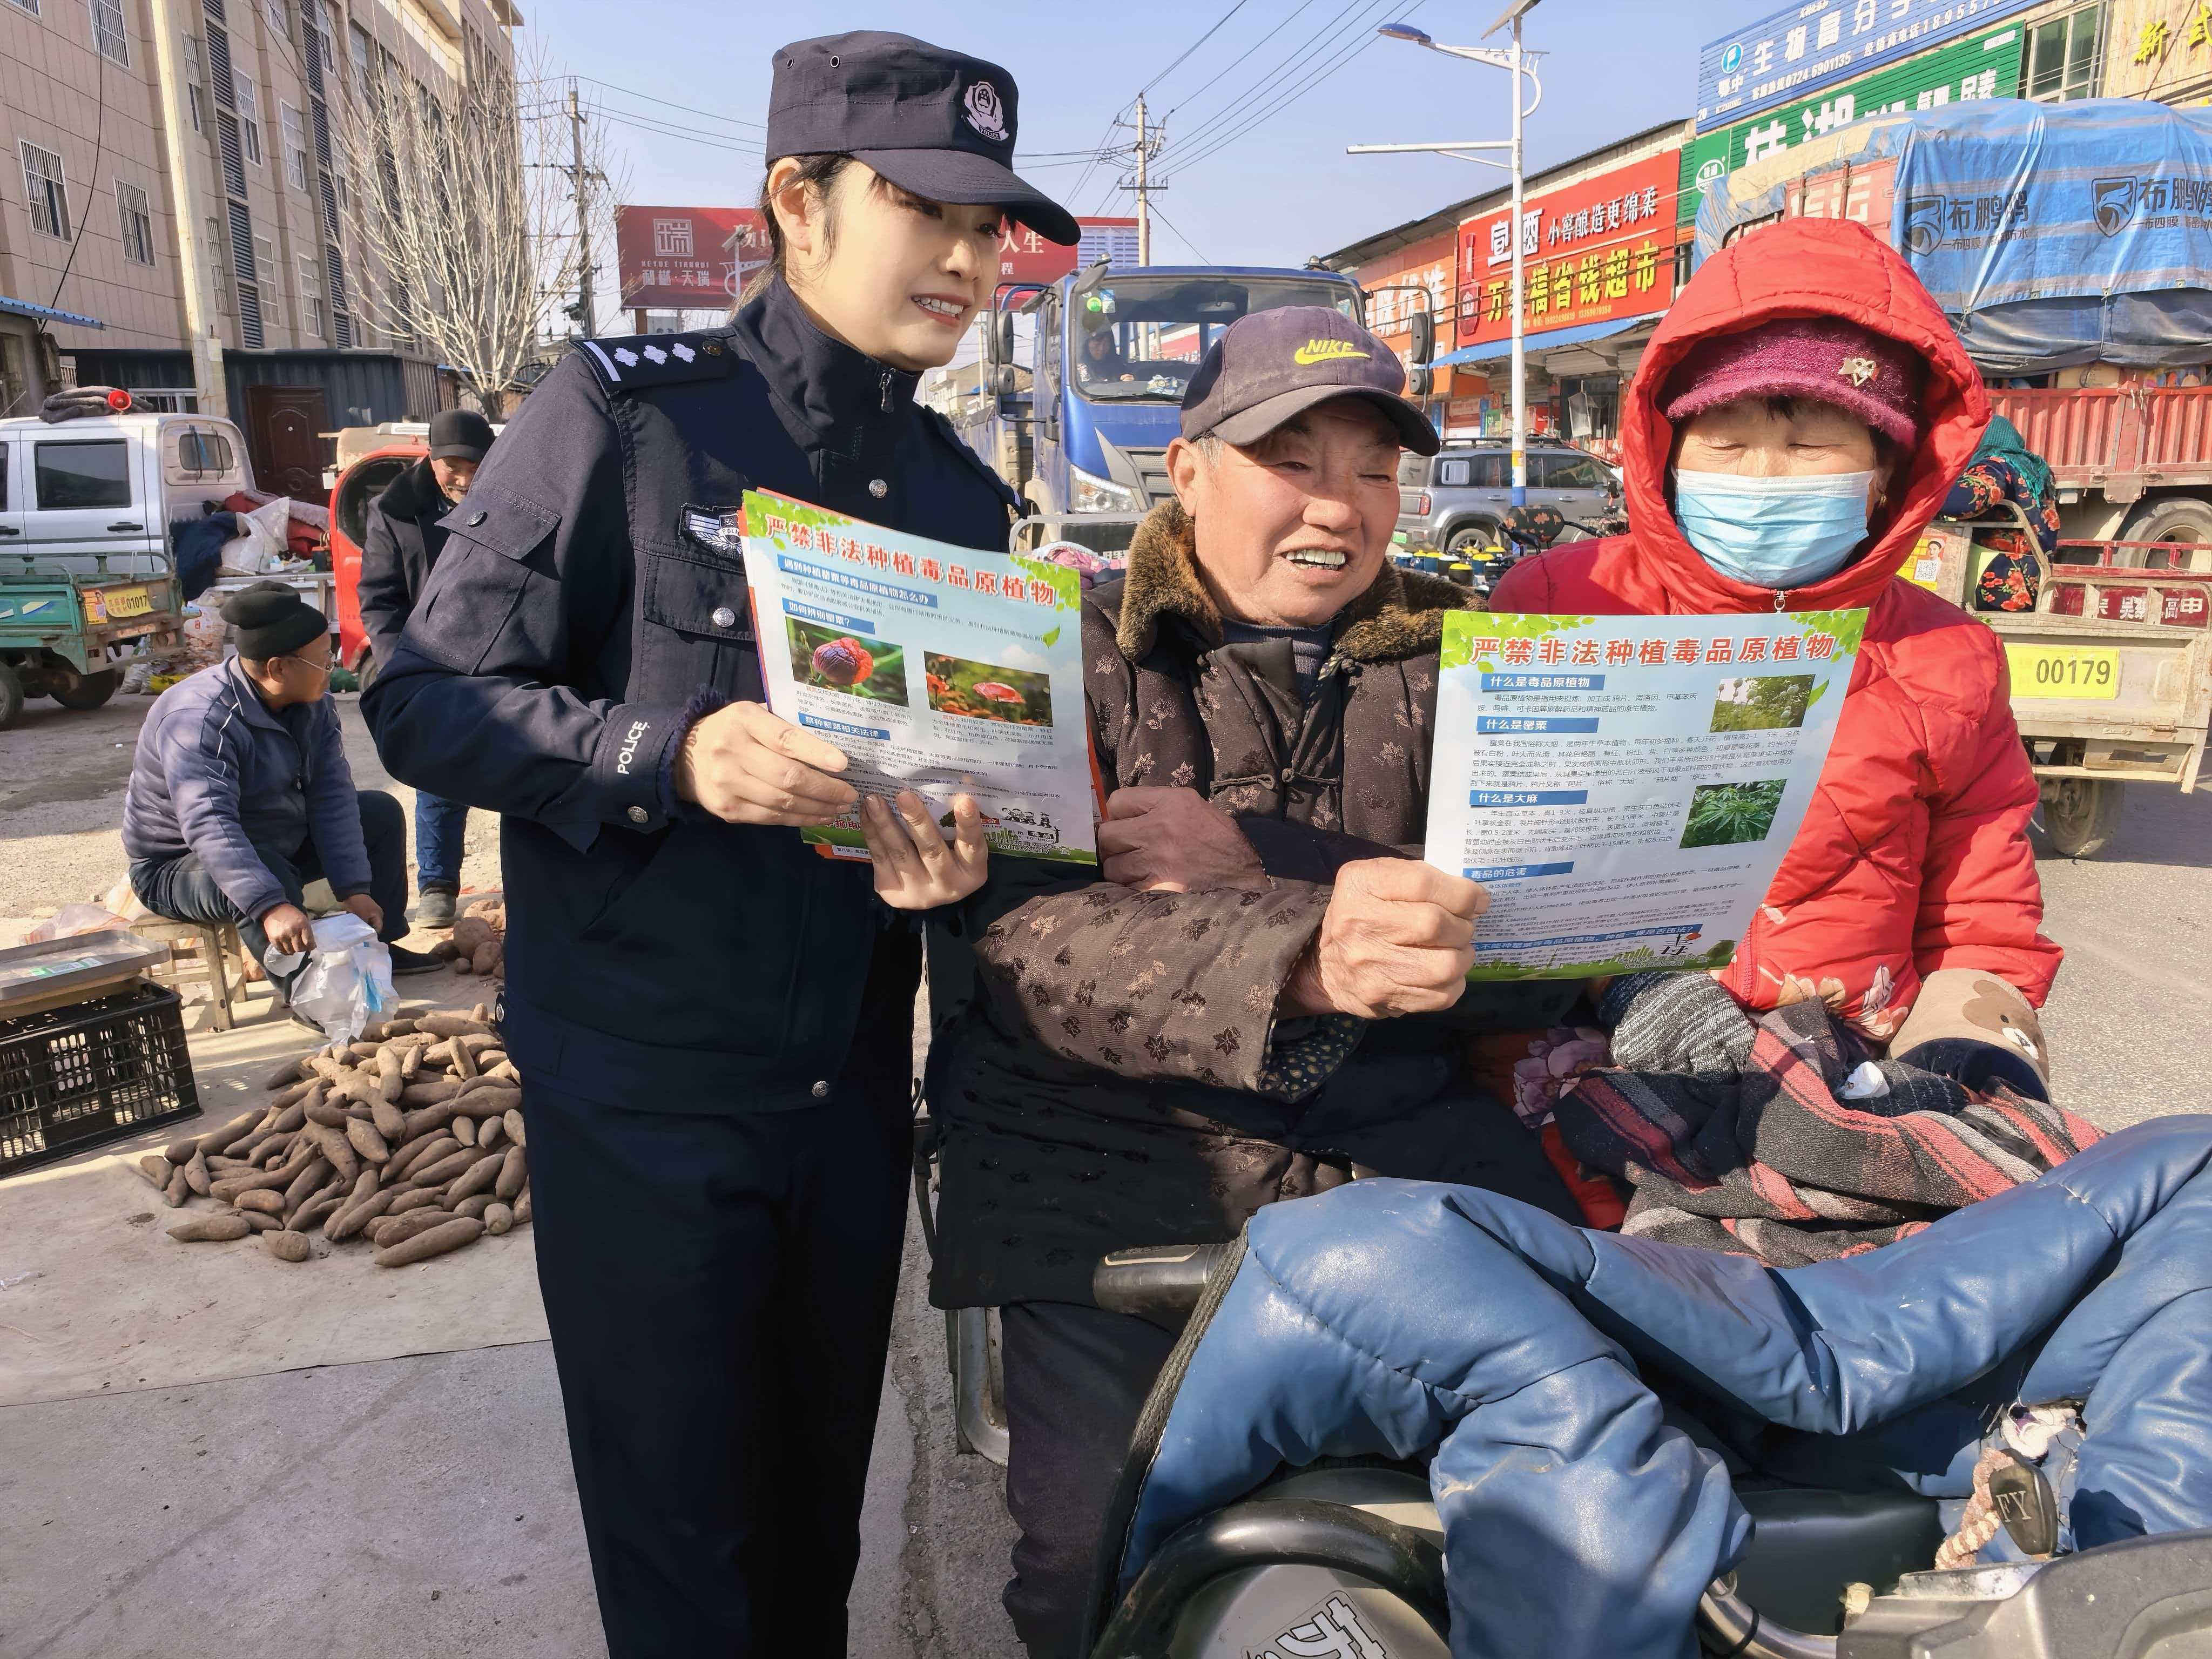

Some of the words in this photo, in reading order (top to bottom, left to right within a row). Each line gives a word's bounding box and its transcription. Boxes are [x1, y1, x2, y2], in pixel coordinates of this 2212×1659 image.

[980, 127, 1000, 139] POLICE
[1548, 186, 1657, 246] 小窖酿造更绵柔
[1306, 339, 1355, 354] NIKE
[765, 514, 1055, 606] 严禁非法种植毒品原植物
[126, 595, 147, 610] 01017
[1469, 633, 1836, 667] 严禁非法种植毒品原植物
[2036, 659, 2110, 685] 00179
[1490, 676, 1590, 688] 什么是毒品原植物
[805, 716, 879, 737] 禁种罂粟相关法律
[1486, 720, 1547, 731] 什么是罂粟
[617, 721, 648, 774] POLICE
[1479, 793, 1538, 804] 什么是大麻
[1471, 867, 1527, 879] 毒品的危害
[1996, 1491, 2032, 1522] FY
